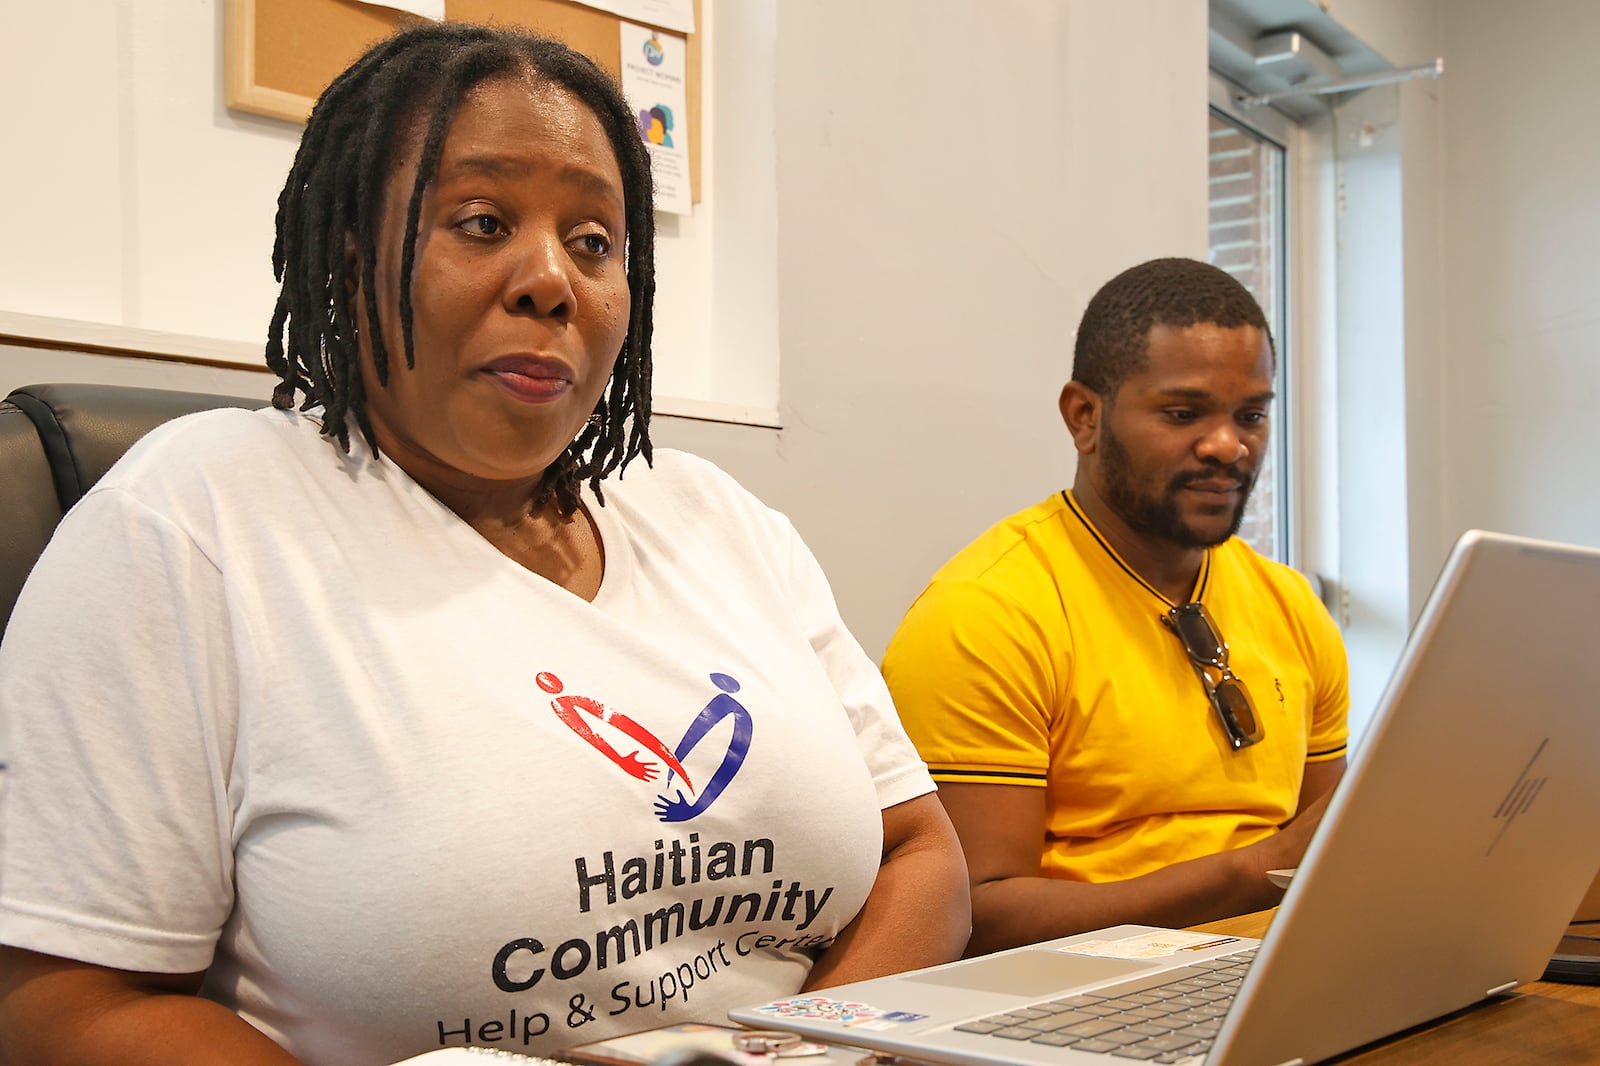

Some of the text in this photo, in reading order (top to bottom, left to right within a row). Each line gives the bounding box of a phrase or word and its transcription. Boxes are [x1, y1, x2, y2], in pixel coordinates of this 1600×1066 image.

[575, 833, 775, 913] Haitian
[492, 880, 834, 993] Community
[437, 1009, 549, 1045] Help
[566, 993, 597, 1029] &
[609, 939, 731, 1017] Support
